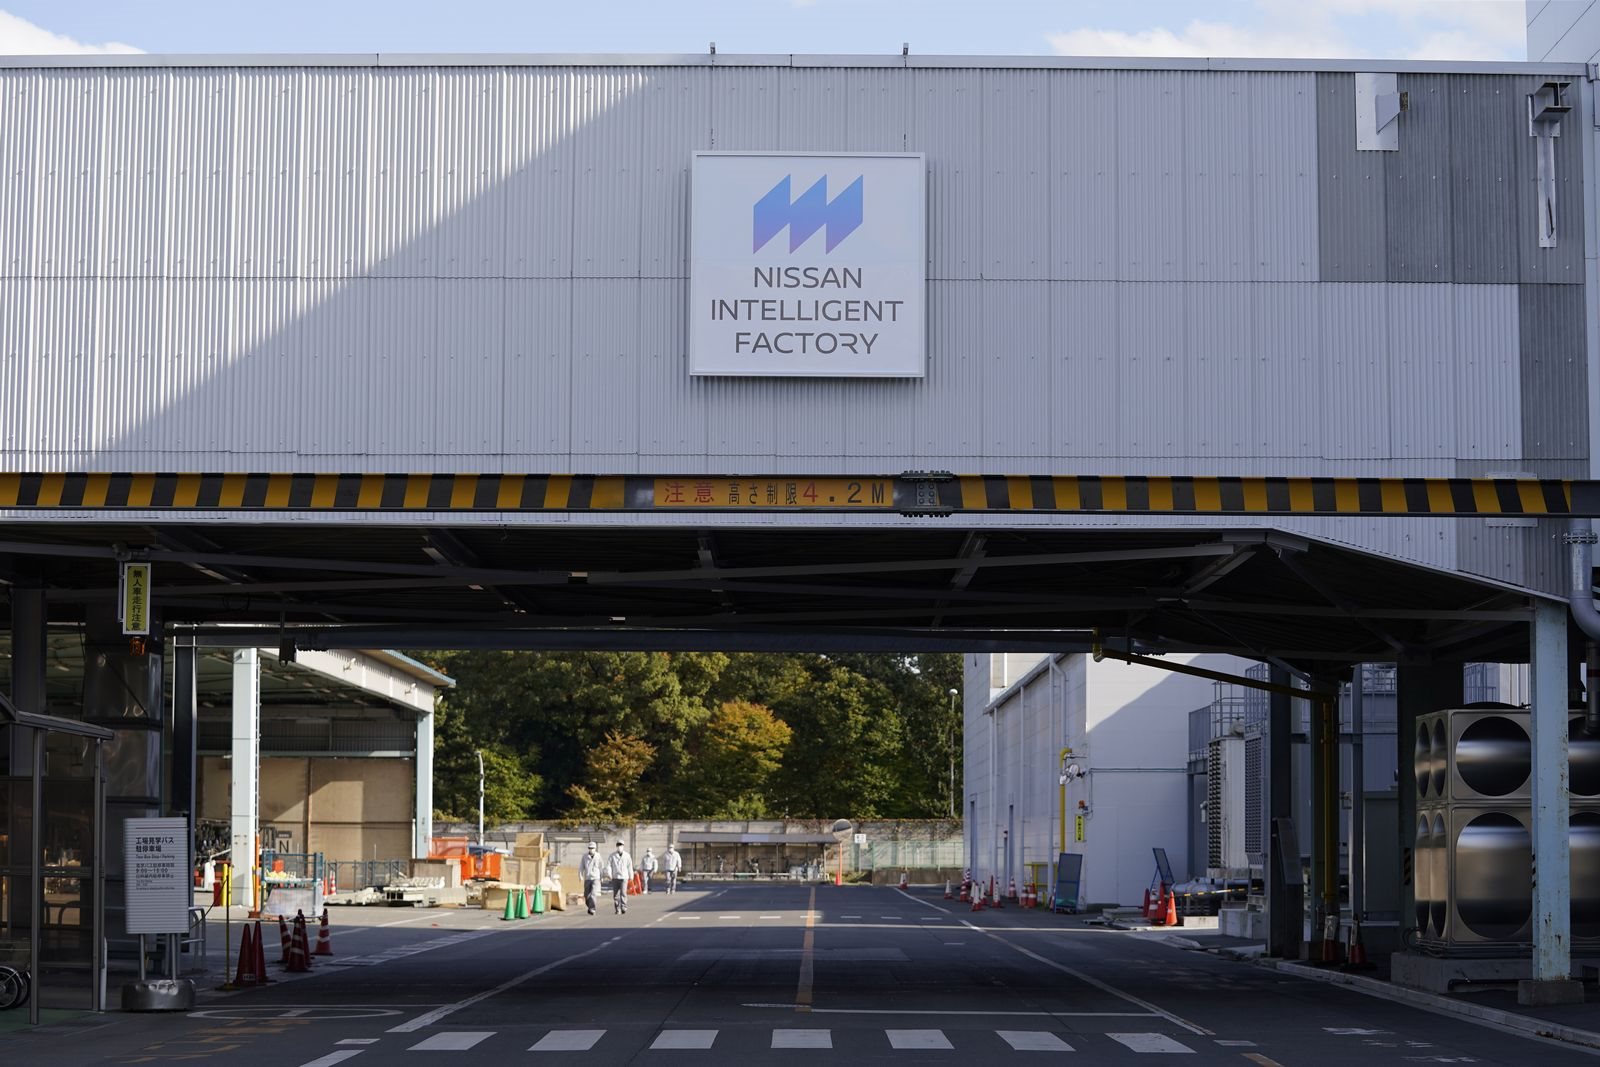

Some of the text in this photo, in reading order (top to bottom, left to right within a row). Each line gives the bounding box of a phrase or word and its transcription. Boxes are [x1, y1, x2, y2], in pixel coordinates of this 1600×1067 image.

[754, 267, 862, 288] NISSAN
[711, 299, 904, 321] INTELLIGENT
[735, 332, 879, 354] FACTORY
